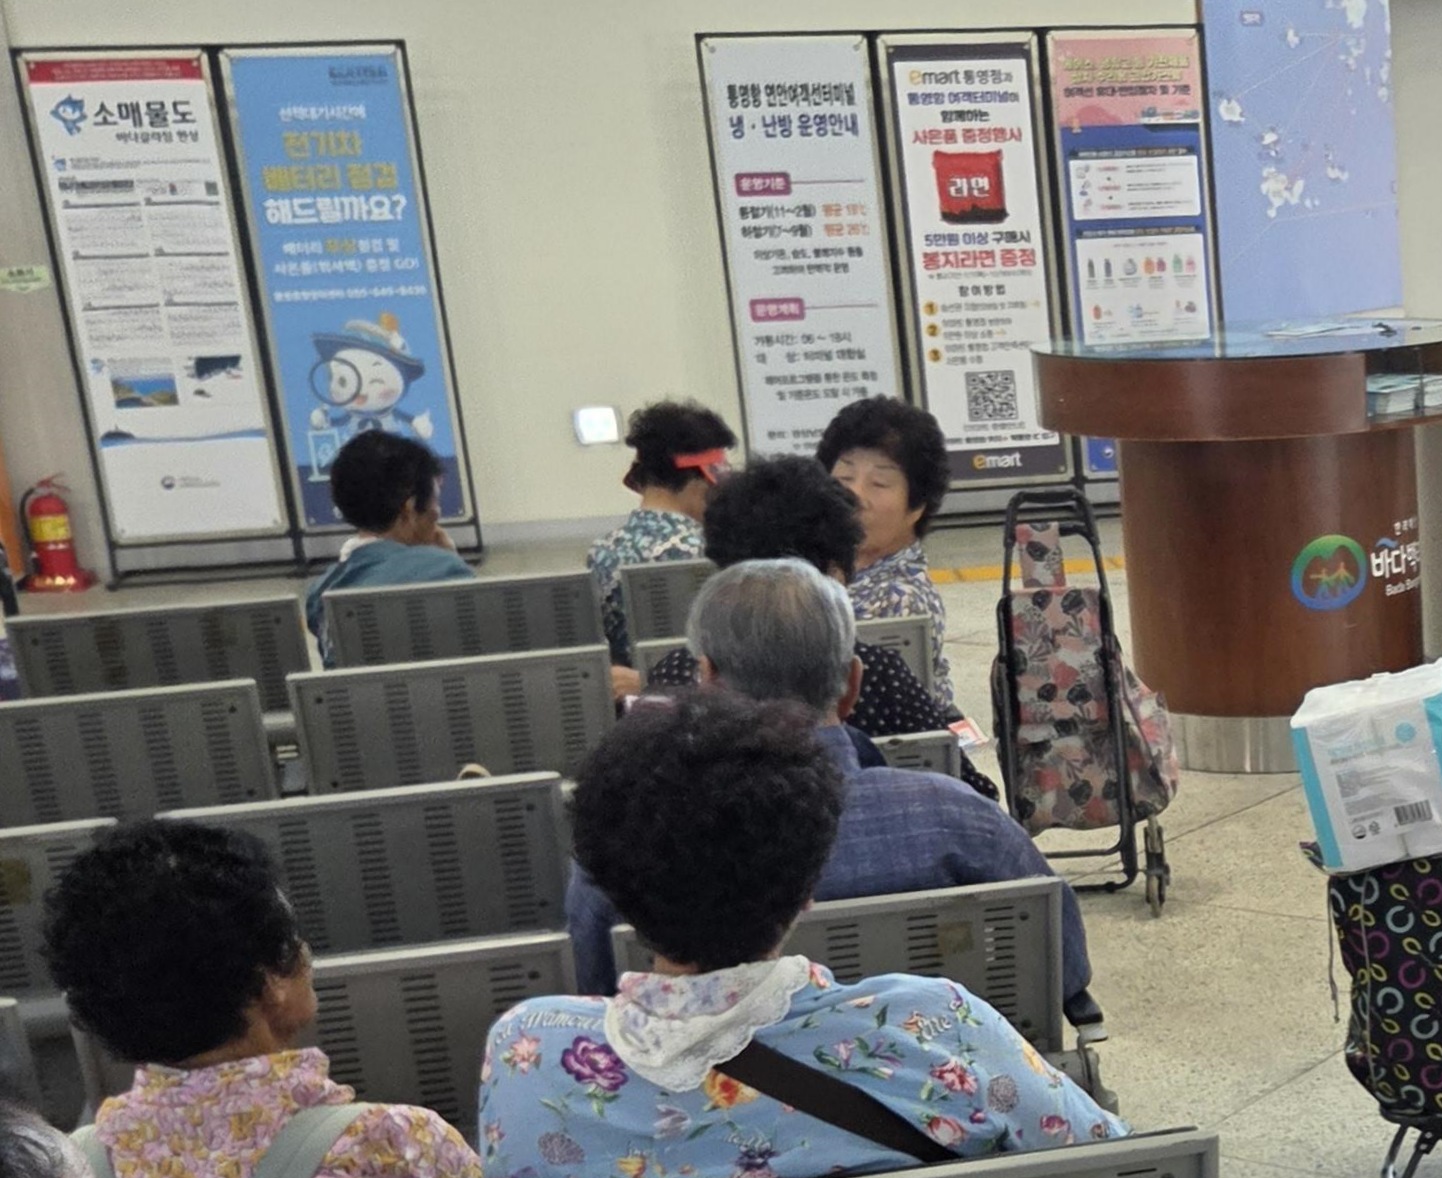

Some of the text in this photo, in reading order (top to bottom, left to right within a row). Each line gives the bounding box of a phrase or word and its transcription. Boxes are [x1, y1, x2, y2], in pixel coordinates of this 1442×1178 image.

[909, 69, 1013, 85] emart 통영점과
[727, 82, 856, 108] 통영항 연안여객선터미널
[907, 92, 945, 105] 통영항
[93, 99, 196, 128] 소매물도
[941, 109, 990, 123] 함께하는
[797, 113, 859, 137] 운영안내
[282, 130, 363, 159] 전기차
[913, 127, 1022, 145] 사은품 증정행사
[262, 165, 340, 190] 배터리
[949, 176, 990, 197] 라면
[263, 194, 407, 224] 해드릴까요?
[924, 230, 1031, 247] 5만원 이상 구매시
[922, 248, 1036, 270] 봉지라면 증정
[973, 451, 1023, 470] emart
